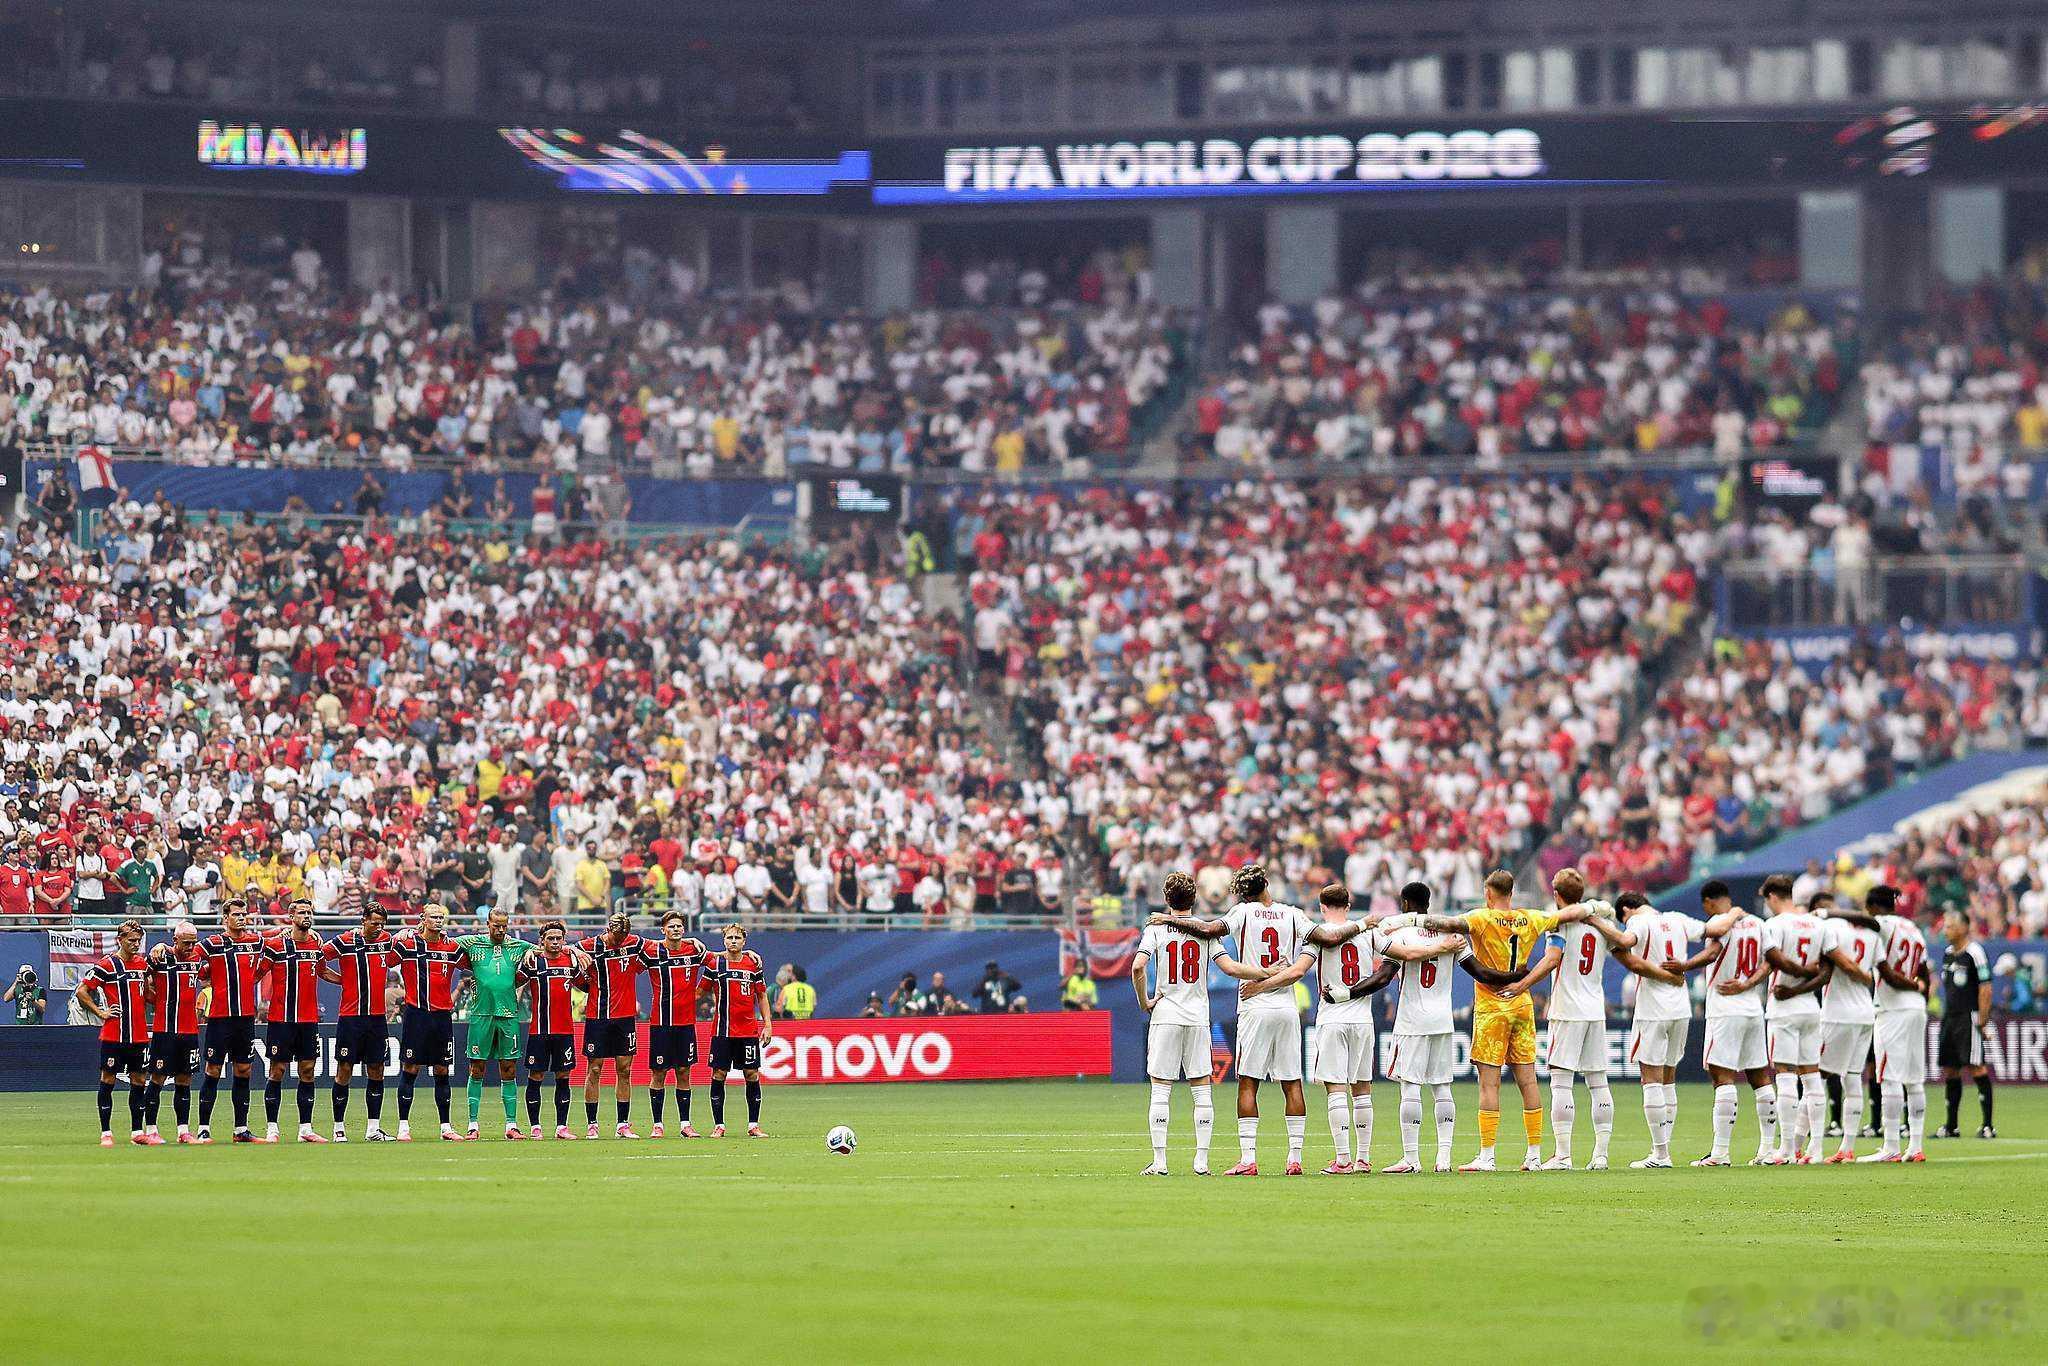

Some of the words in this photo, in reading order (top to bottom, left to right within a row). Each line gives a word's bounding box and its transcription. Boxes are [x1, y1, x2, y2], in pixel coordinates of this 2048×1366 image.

[197, 119, 368, 170] MIAMI
[944, 146, 1056, 191] FIFA
[1056, 139, 1243, 188] WORLD
[1246, 136, 1355, 184] CUP
[619, 958, 630, 972] 17
[1166, 940, 1200, 984] 18
[1261, 927, 1280, 967] 3
[1341, 943, 1359, 986] 8
[1508, 934, 1518, 972] 1
[1579, 932, 1596, 975] 9
[1735, 938, 1758, 979] 10
[1796, 937, 1810, 966] 5
[496, 962, 501, 975] 1
[564, 979, 570, 991] 6
[1420, 957, 1436, 988] 6
[741, 982, 751, 995] 21
[512, 1034, 517, 1048] 1
[564, 1046, 572, 1060] 6
[728, 1032, 953, 1080] enovo
[745, 1045, 756, 1059] 21
[1983, 1021, 2048, 1080] AIR
